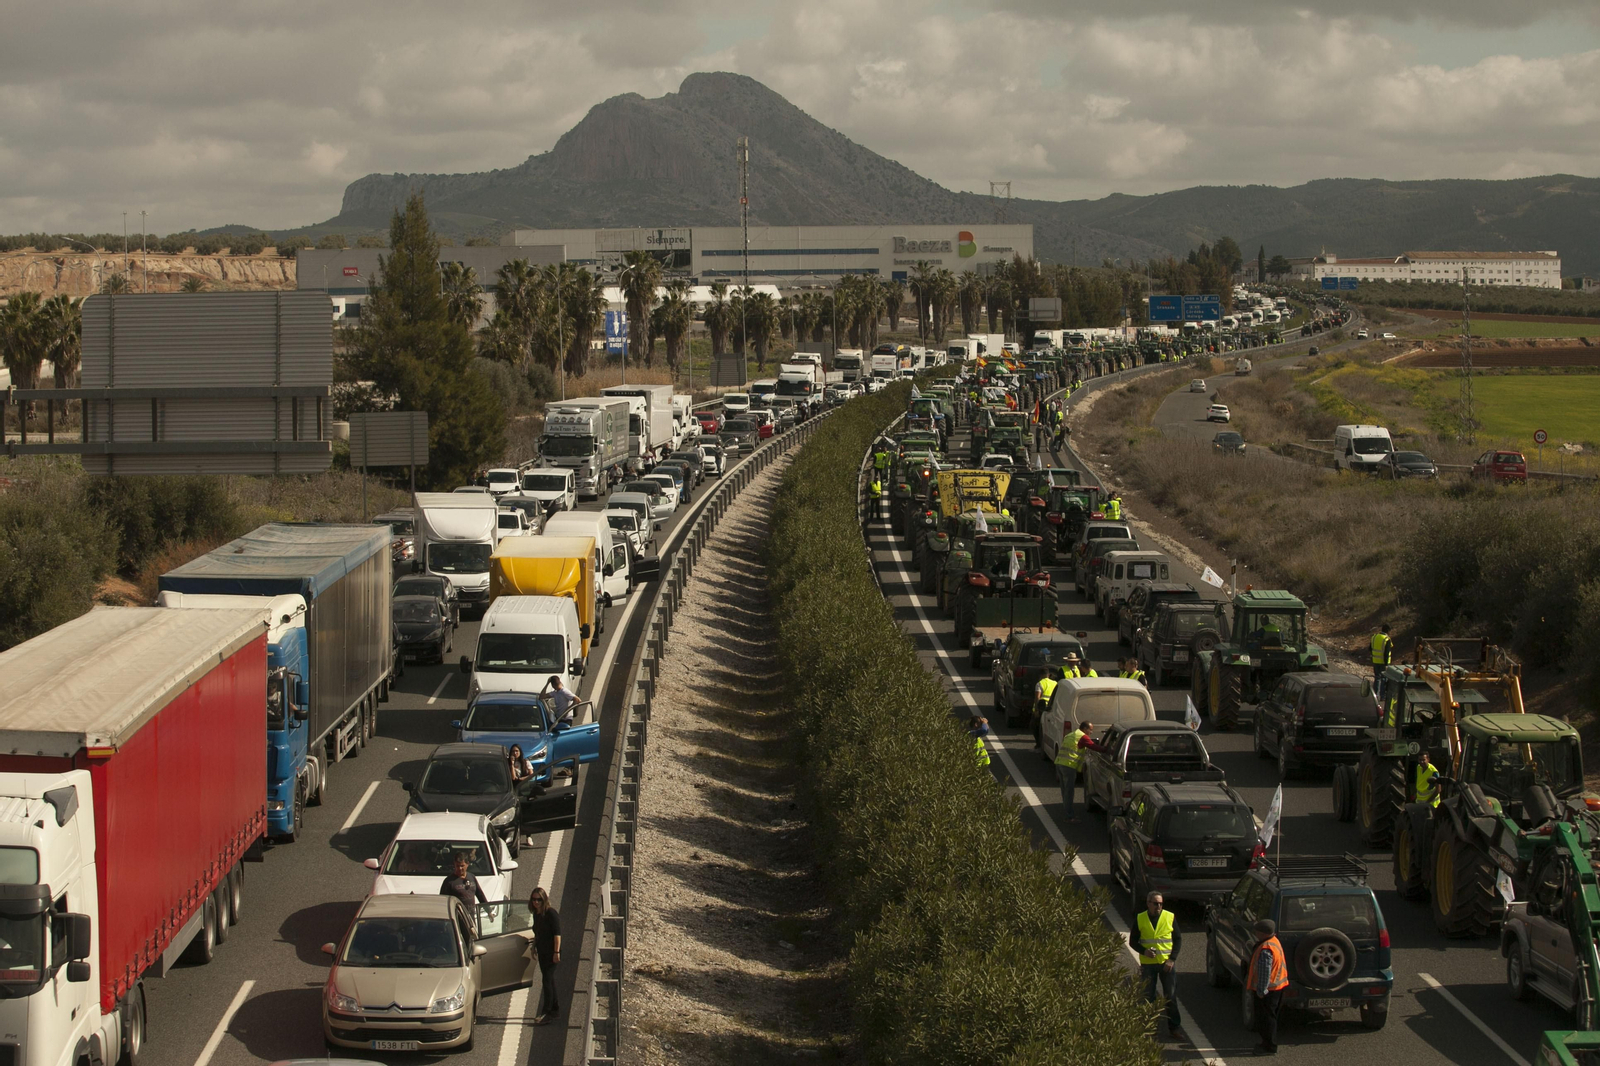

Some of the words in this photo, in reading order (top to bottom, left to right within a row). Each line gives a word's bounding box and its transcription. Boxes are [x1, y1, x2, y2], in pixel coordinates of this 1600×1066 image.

[892, 236, 953, 253] Baeza
[1410, 742, 1418, 753] 30
[377, 1041, 397, 1049] 1538
[400, 1041, 416, 1049] FTL
